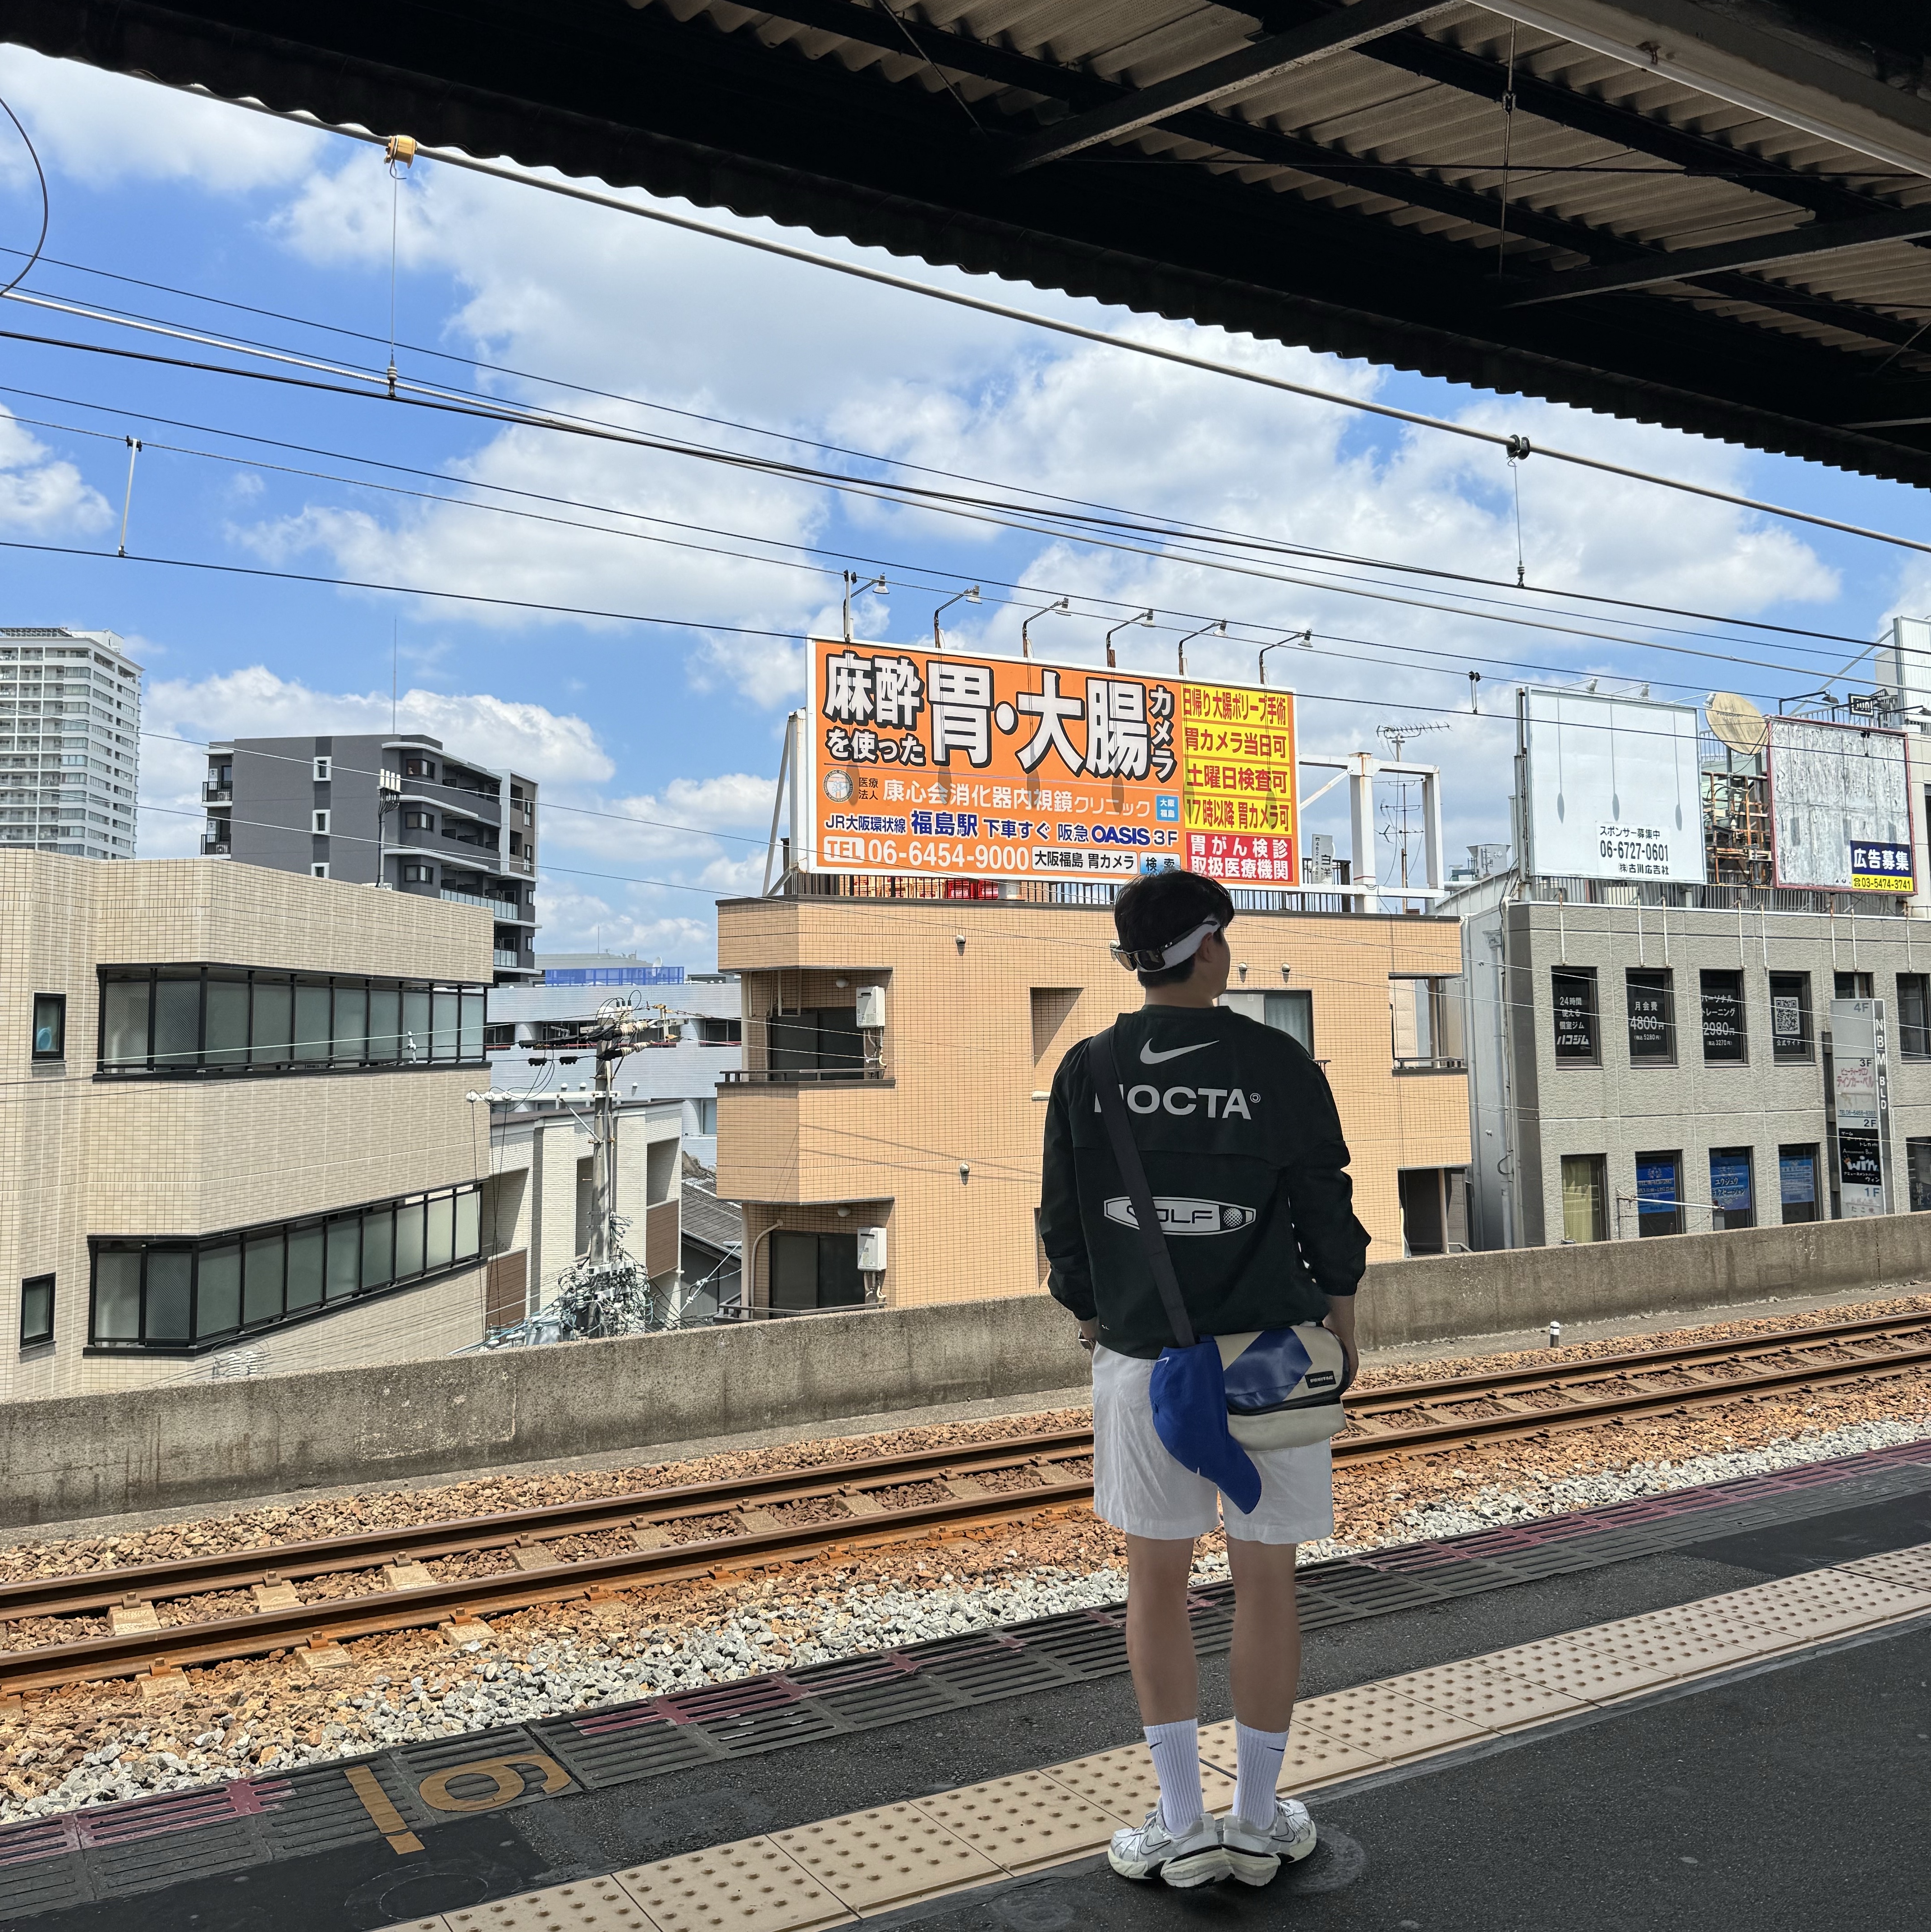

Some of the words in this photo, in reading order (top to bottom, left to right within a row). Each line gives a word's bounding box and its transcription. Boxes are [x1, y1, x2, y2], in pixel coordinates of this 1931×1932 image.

[823, 651, 924, 730] 麻酔
[1184, 688, 1286, 725] 日帰り大腸ポリープ手術
[1148, 685, 1178, 783] カメラ
[1186, 728, 1287, 759] 胃カメラ当日可
[826, 726, 926, 766] を使った
[859, 777, 878, 788] 医療
[1187, 766, 1288, 794] 土曜日検査可
[859, 789, 878, 800] 法人
[883, 779, 1150, 817] 康心会消化器内視鏡クリニック
[1160, 798, 1174, 807] 大阪
[1187, 799, 1235, 828] 17時以降
[1238, 803, 1289, 832] 胃カメラ可
[826, 814, 906, 833] JR大阪環状線
[912, 810, 977, 837] 福島駅
[984, 819, 1050, 840] 下車すぐ
[1058, 823, 1088, 842] 阪急
[1092, 825, 1150, 845] OASIS
[1154, 830, 1177, 845] 3F
[1600, 826, 1660, 840] スポンサー募集中
[828, 840, 861, 859] TEL
[868, 839, 1029, 871] 06-6454-9000
[1191, 835, 1288, 859] 胃がん検診
[1600, 840, 1669, 862] 06-6727-0601
[1035, 851, 1083, 869] 大阪福島
[1088, 854, 1135, 870] 胃カメラ
[1191, 856, 1289, 880] 取扱医療機関
[1854, 848, 1909, 871] 広告募集
[1861, 877, 1911, 890] 03-5474-3741
[1560, 997, 1582, 1005] 24時間
[1635, 1001, 1657, 1010] 月会費
[1854, 1003, 1869, 1012] 4F
[1559, 1021, 1584, 1030] 個室ジム
[1630, 1016, 1664, 1030] 4800円
[1557, 1035, 1589, 1045] ハコジム
[1865, 1188, 1879, 1197] 1F
